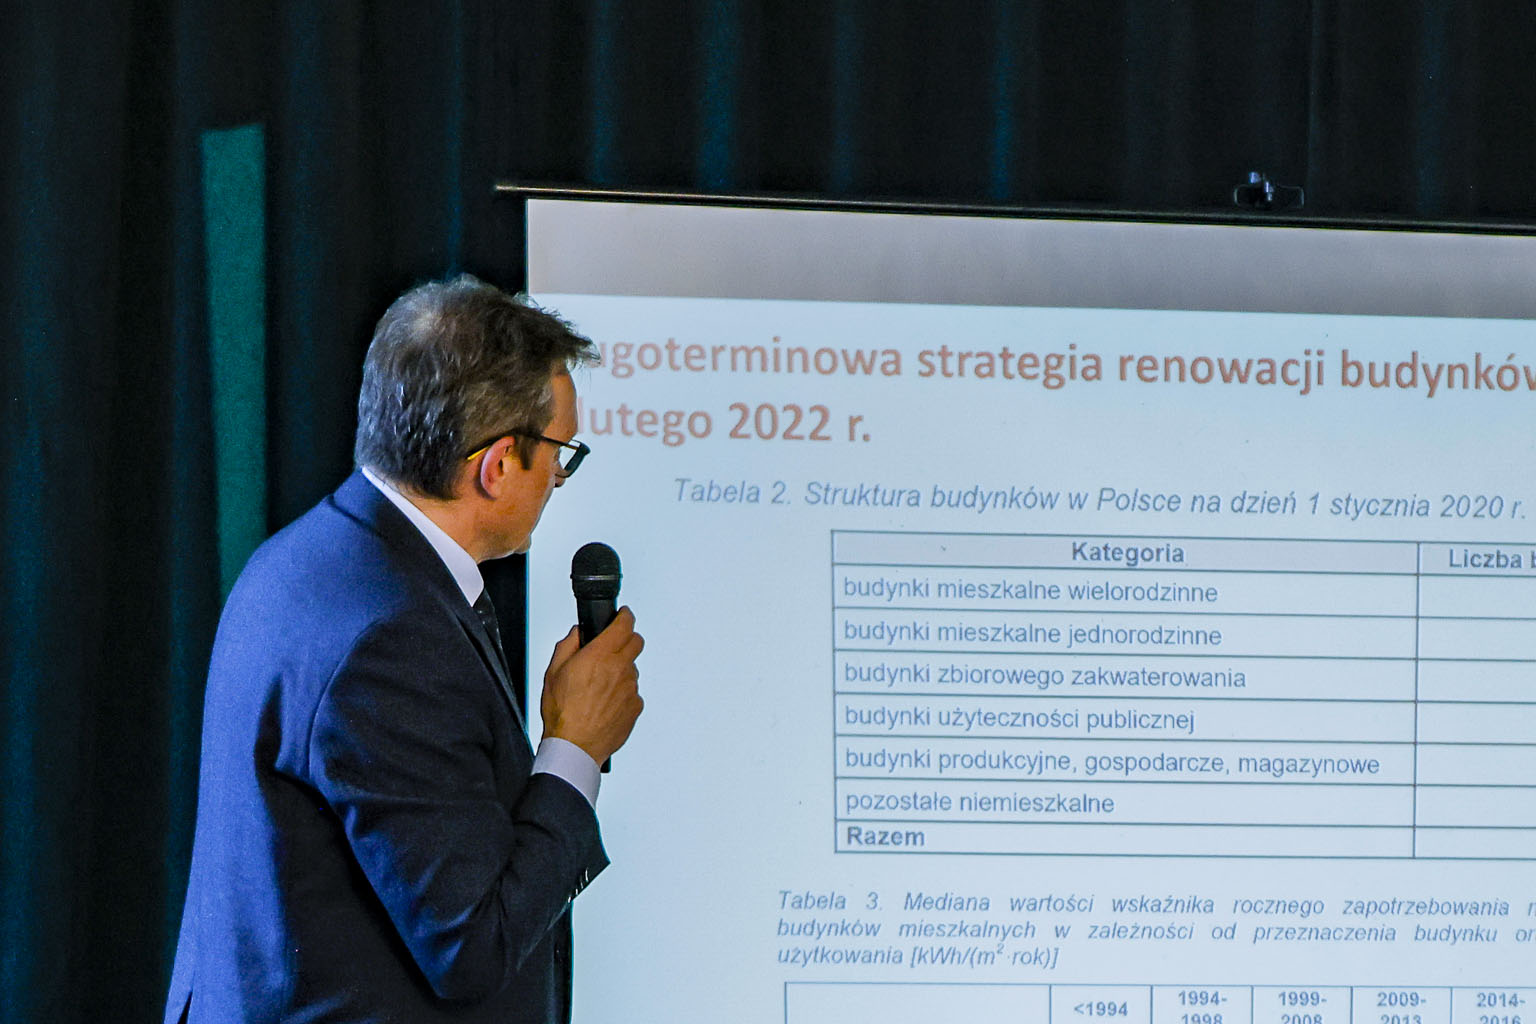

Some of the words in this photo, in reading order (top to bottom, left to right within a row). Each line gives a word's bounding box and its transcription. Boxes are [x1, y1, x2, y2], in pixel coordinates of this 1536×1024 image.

[917, 343, 1103, 389] strategia
[1118, 350, 1325, 395] renowacji
[576, 397, 713, 447] lutego
[728, 402, 832, 442] 2022
[848, 414, 871, 443] r.
[674, 477, 761, 504] Tabela
[770, 479, 791, 505] 2.
[804, 480, 921, 508] Struktura
[930, 484, 1061, 515] budynków
[1067, 492, 1089, 511] w
[1096, 486, 1182, 513] Polsce
[1190, 494, 1221, 514] na
[1230, 490, 1297, 515] dzień
[1309, 492, 1320, 515] 1
[1329, 492, 1430, 522] stycznia
[1439, 494, 1505, 520] 2020
[1510, 500, 1526, 520] r.
[1071, 540, 1185, 566] Kategoria
[1448, 548, 1522, 569] Liczba
[843, 576, 930, 603] budynki
[937, 580, 1061, 601] mieszkalne
[1067, 581, 1218, 603] wielorodzinne
[844, 620, 930, 646] budynki
[937, 623, 1061, 644] mieszkalne
[1066, 624, 1222, 649] jednorodzinne
[844, 662, 931, 688] budynki
[937, 664, 1065, 691] zbiorowego
[1070, 666, 1246, 688] zakwaterowania
[845, 705, 931, 731] budynki
[938, 707, 1079, 732] użyteczności
[1086, 709, 1195, 735] publicznej
[845, 748, 931, 774] budynki
[938, 750, 1077, 776] produkcyjne,
[1084, 752, 1230, 777] gospodarcze,
[1238, 757, 1380, 779] magazynowe
[845, 791, 952, 815] pozostałe
[959, 793, 1115, 814] niemieszkalne
[846, 825, 925, 847] Razem
[778, 890, 847, 910] Tabela
[865, 890, 883, 911] 3.
[903, 891, 990, 912] Mediana
[1009, 893, 1094, 913] wartości
[1111, 894, 1215, 914] wskaźnika
[1232, 899, 1325, 919] rocznego
[1342, 897, 1510, 919] zapotrzebowania
[776, 917, 882, 941] budynków
[898, 919, 1036, 943] mieszkalnych
[1054, 925, 1071, 939] w
[1087, 921, 1194, 940] zależności
[1211, 922, 1237, 940] od
[1252, 926, 1397, 945] przeznaczenia
[1413, 923, 1498, 946] budynku
[777, 945, 904, 968] użytkowania
[1073, 1001, 1128, 1017] <1994
[1178, 990, 1228, 1006] 1994-
[1278, 991, 1327, 1007] 1999-
[1376, 991, 1427, 1008] 2009-
[1476, 992, 1526, 1008] 2014-
